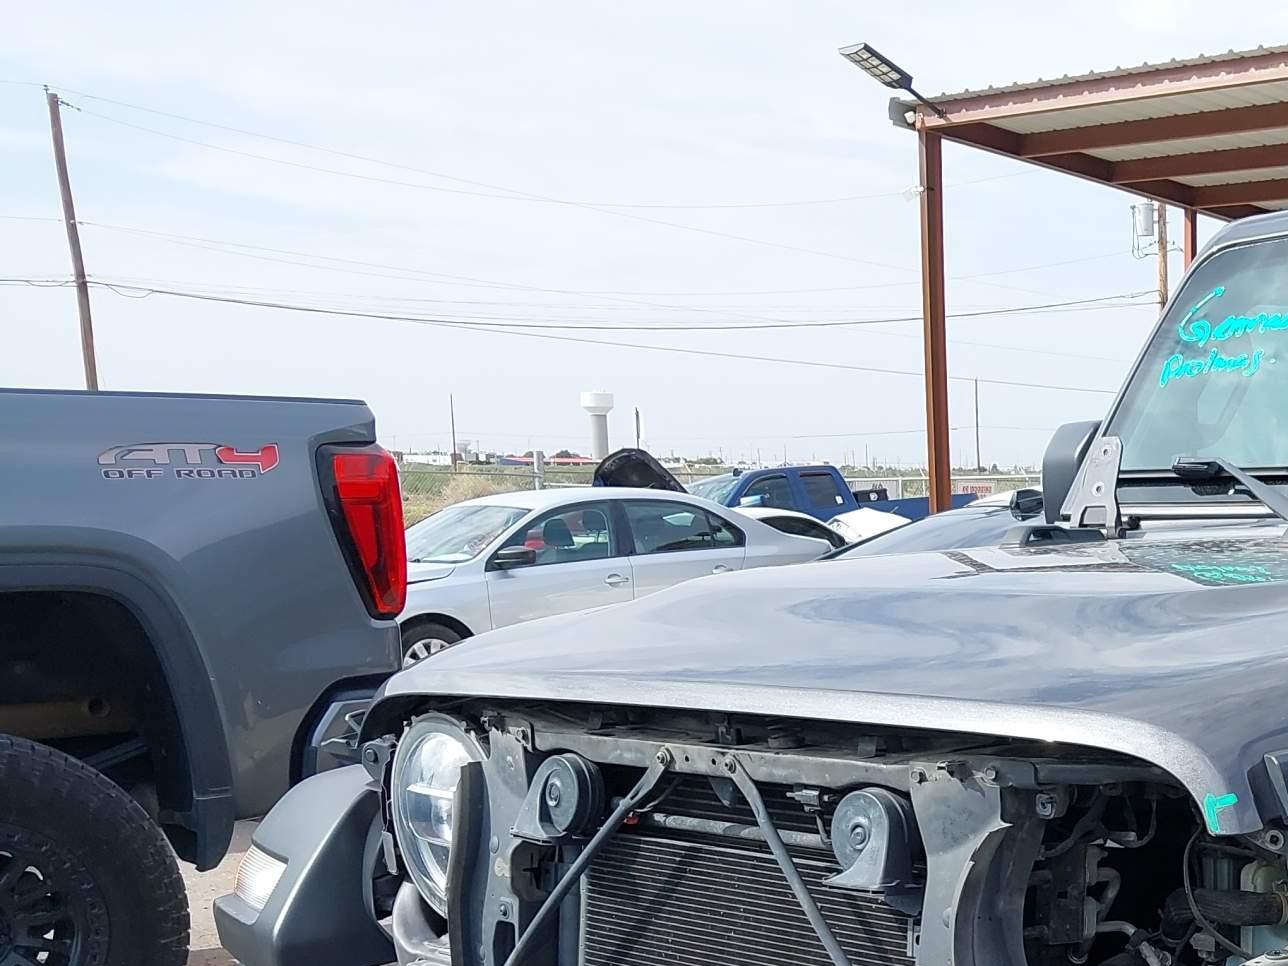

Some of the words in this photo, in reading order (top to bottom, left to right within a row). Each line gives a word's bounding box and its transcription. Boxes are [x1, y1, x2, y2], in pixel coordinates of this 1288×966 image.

[97, 441, 280, 474] AT4
[100, 467, 165, 481] OFF
[173, 467, 260, 481] ROAD
